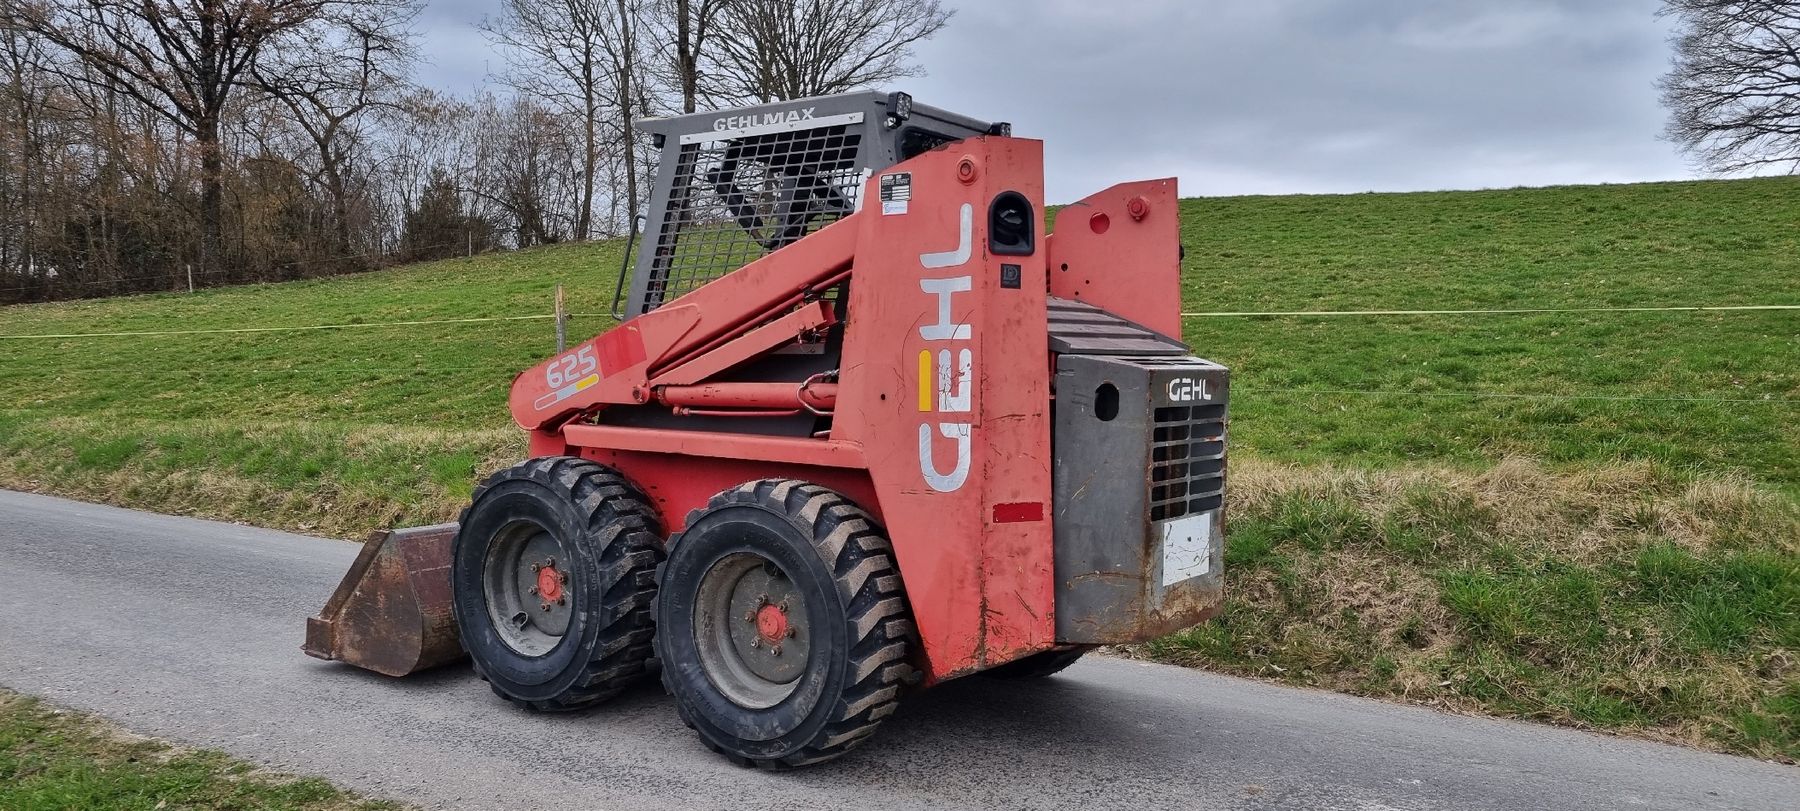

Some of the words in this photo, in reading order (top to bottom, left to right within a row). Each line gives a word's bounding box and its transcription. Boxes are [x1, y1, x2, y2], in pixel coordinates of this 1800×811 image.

[713, 107, 815, 132] GEHLMAX
[919, 203, 973, 493] GEHL
[546, 344, 596, 389] 625
[1169, 377, 1212, 401] GEHL
